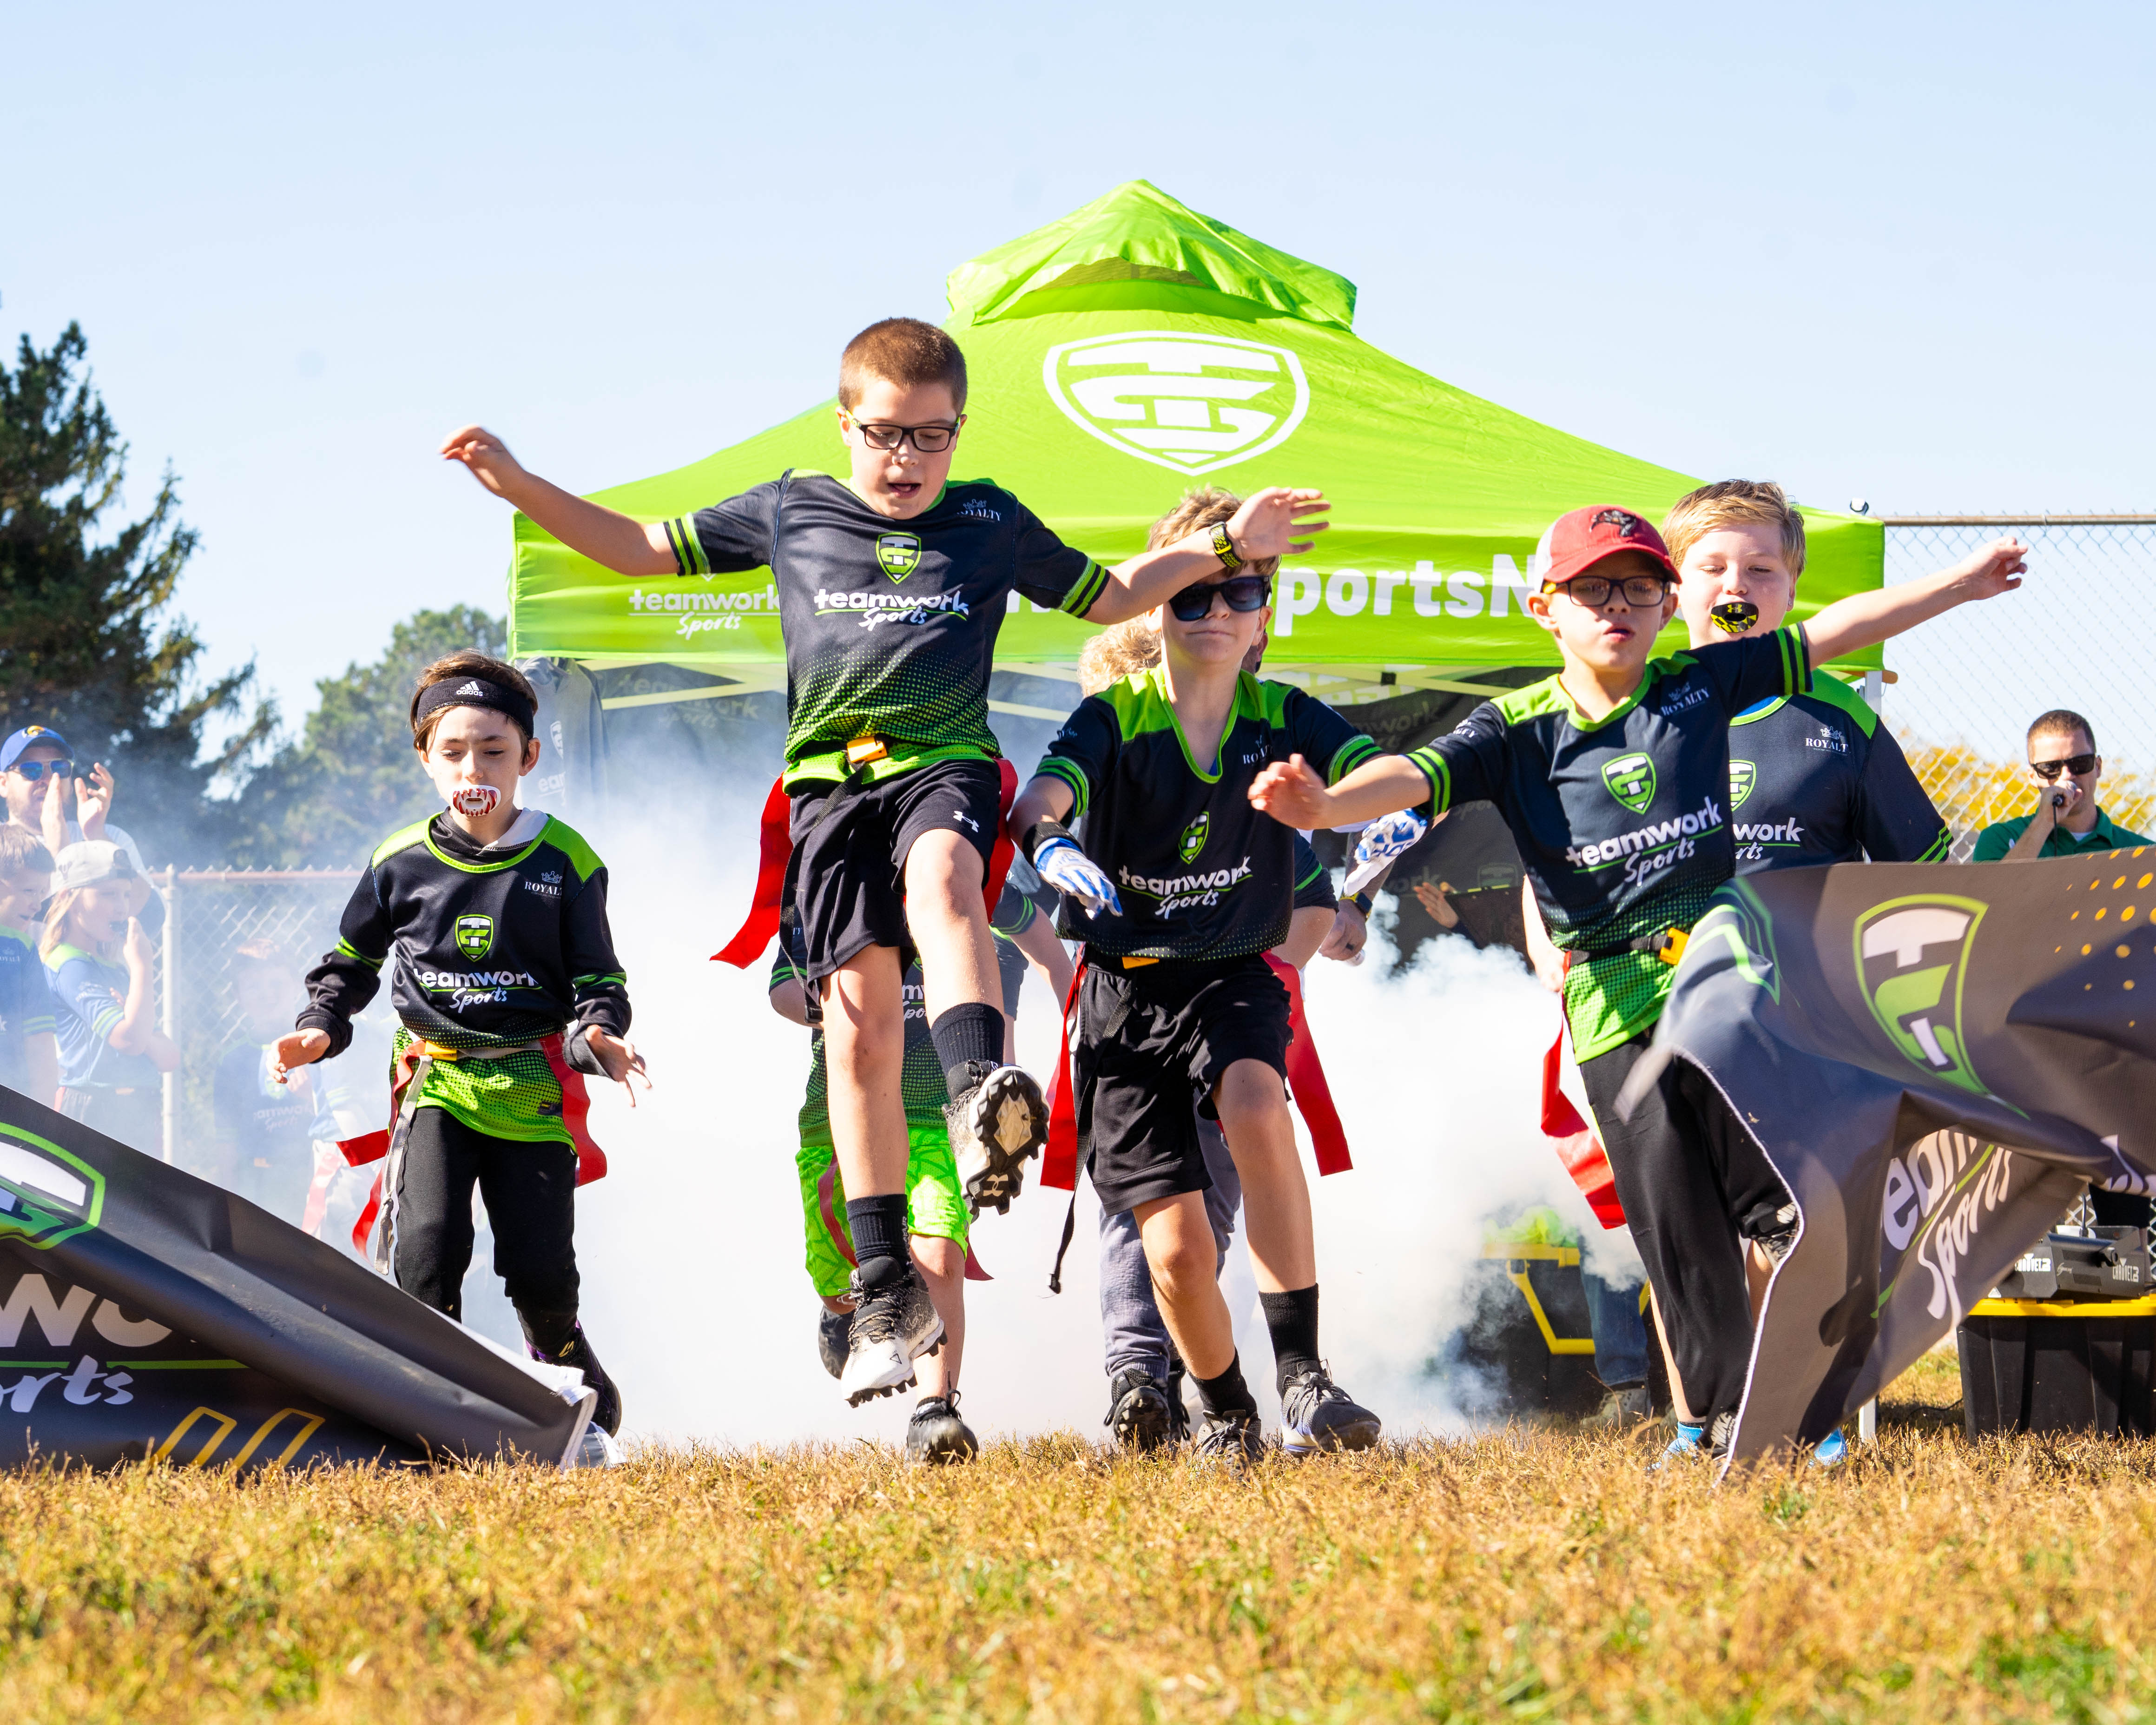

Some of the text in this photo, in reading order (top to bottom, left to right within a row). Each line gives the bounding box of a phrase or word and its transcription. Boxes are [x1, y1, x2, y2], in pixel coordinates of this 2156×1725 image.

[629, 584, 780, 611] teamwork
[814, 588, 969, 615] teamwork
[676, 611, 741, 640] Sports
[859, 606, 928, 631] Sports
[1805, 737, 1851, 753] ROYALT
[1565, 796, 1722, 867] teamwork
[1733, 817, 1805, 842] work
[1625, 839, 1695, 886] Sports
[1735, 841, 1763, 860] rts
[1119, 856, 1252, 896] teamwork
[1154, 889, 1219, 920] Sports
[449, 986, 508, 1014] Sports
[0, 1355, 134, 1413] rts
